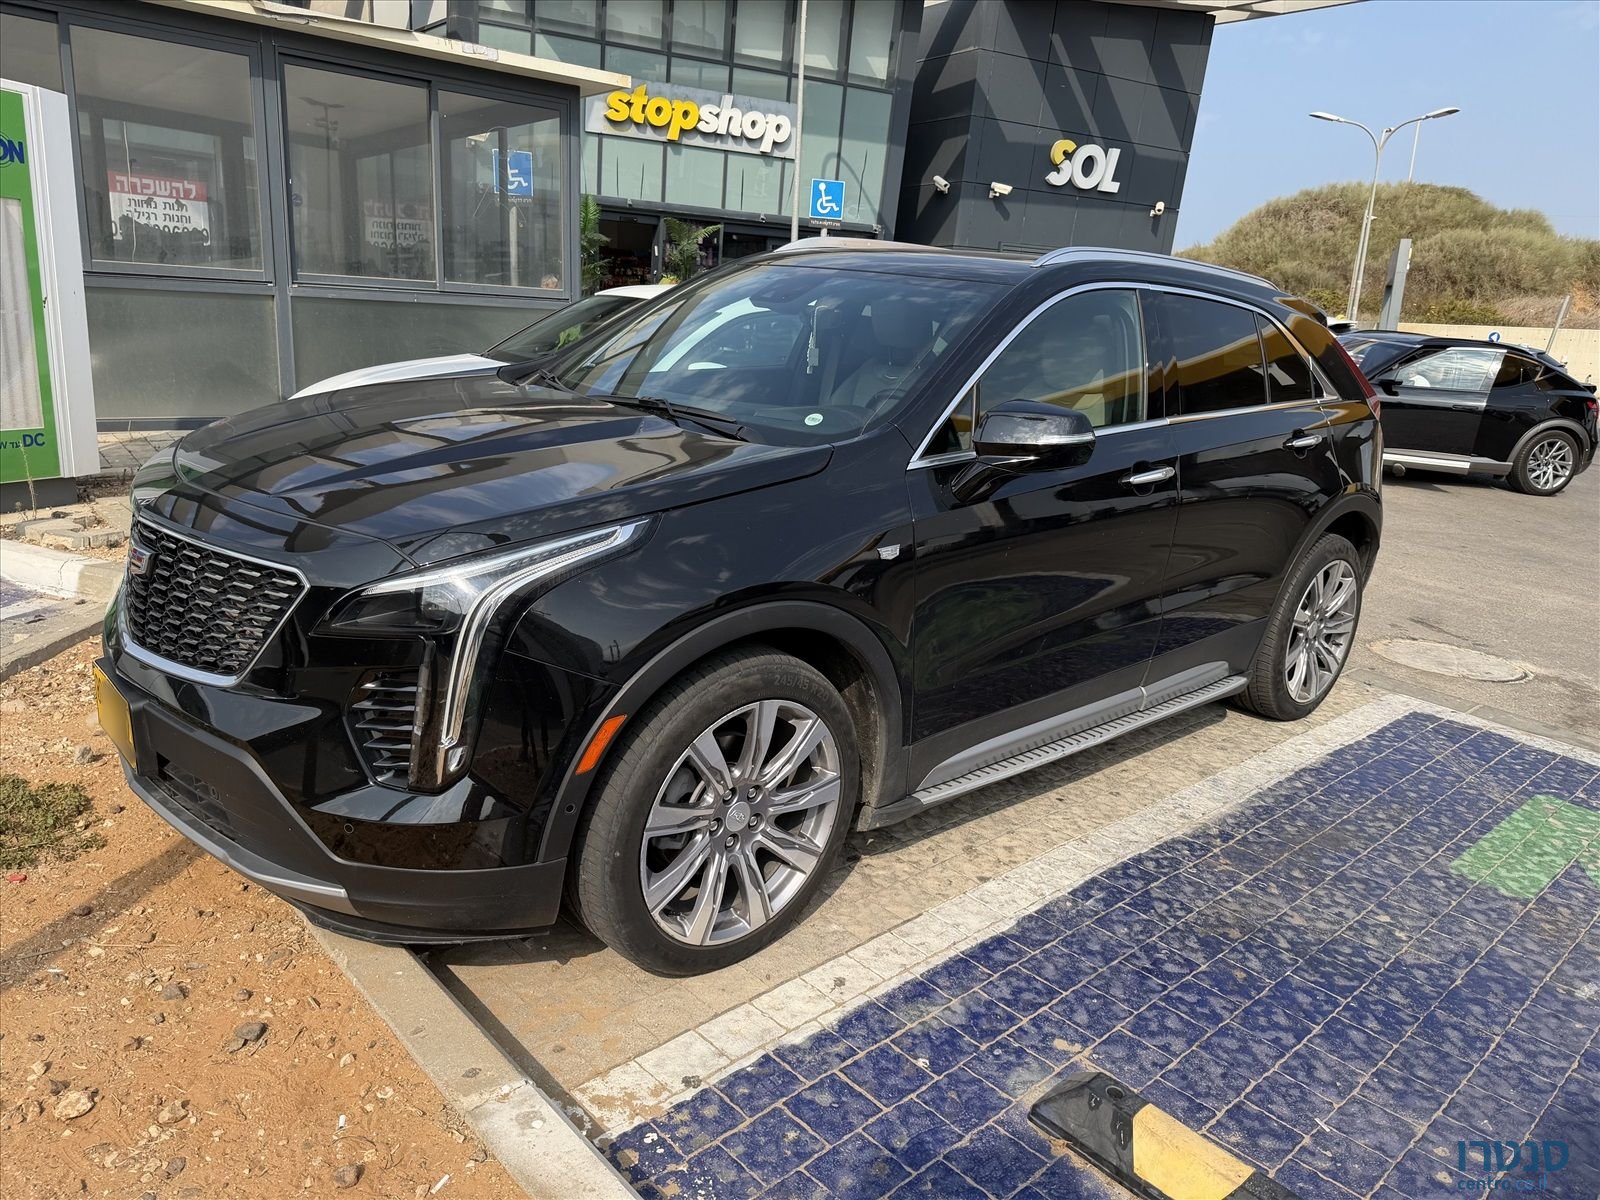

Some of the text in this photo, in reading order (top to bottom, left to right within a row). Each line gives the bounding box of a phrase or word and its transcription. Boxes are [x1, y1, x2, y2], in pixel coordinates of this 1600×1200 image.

[604, 83, 791, 153] stopshop
[1045, 139, 1121, 193] SOL
[115, 175, 196, 199] להשכרה
[162, 212, 191, 224] וחנות
[22, 432, 46, 448] DC
